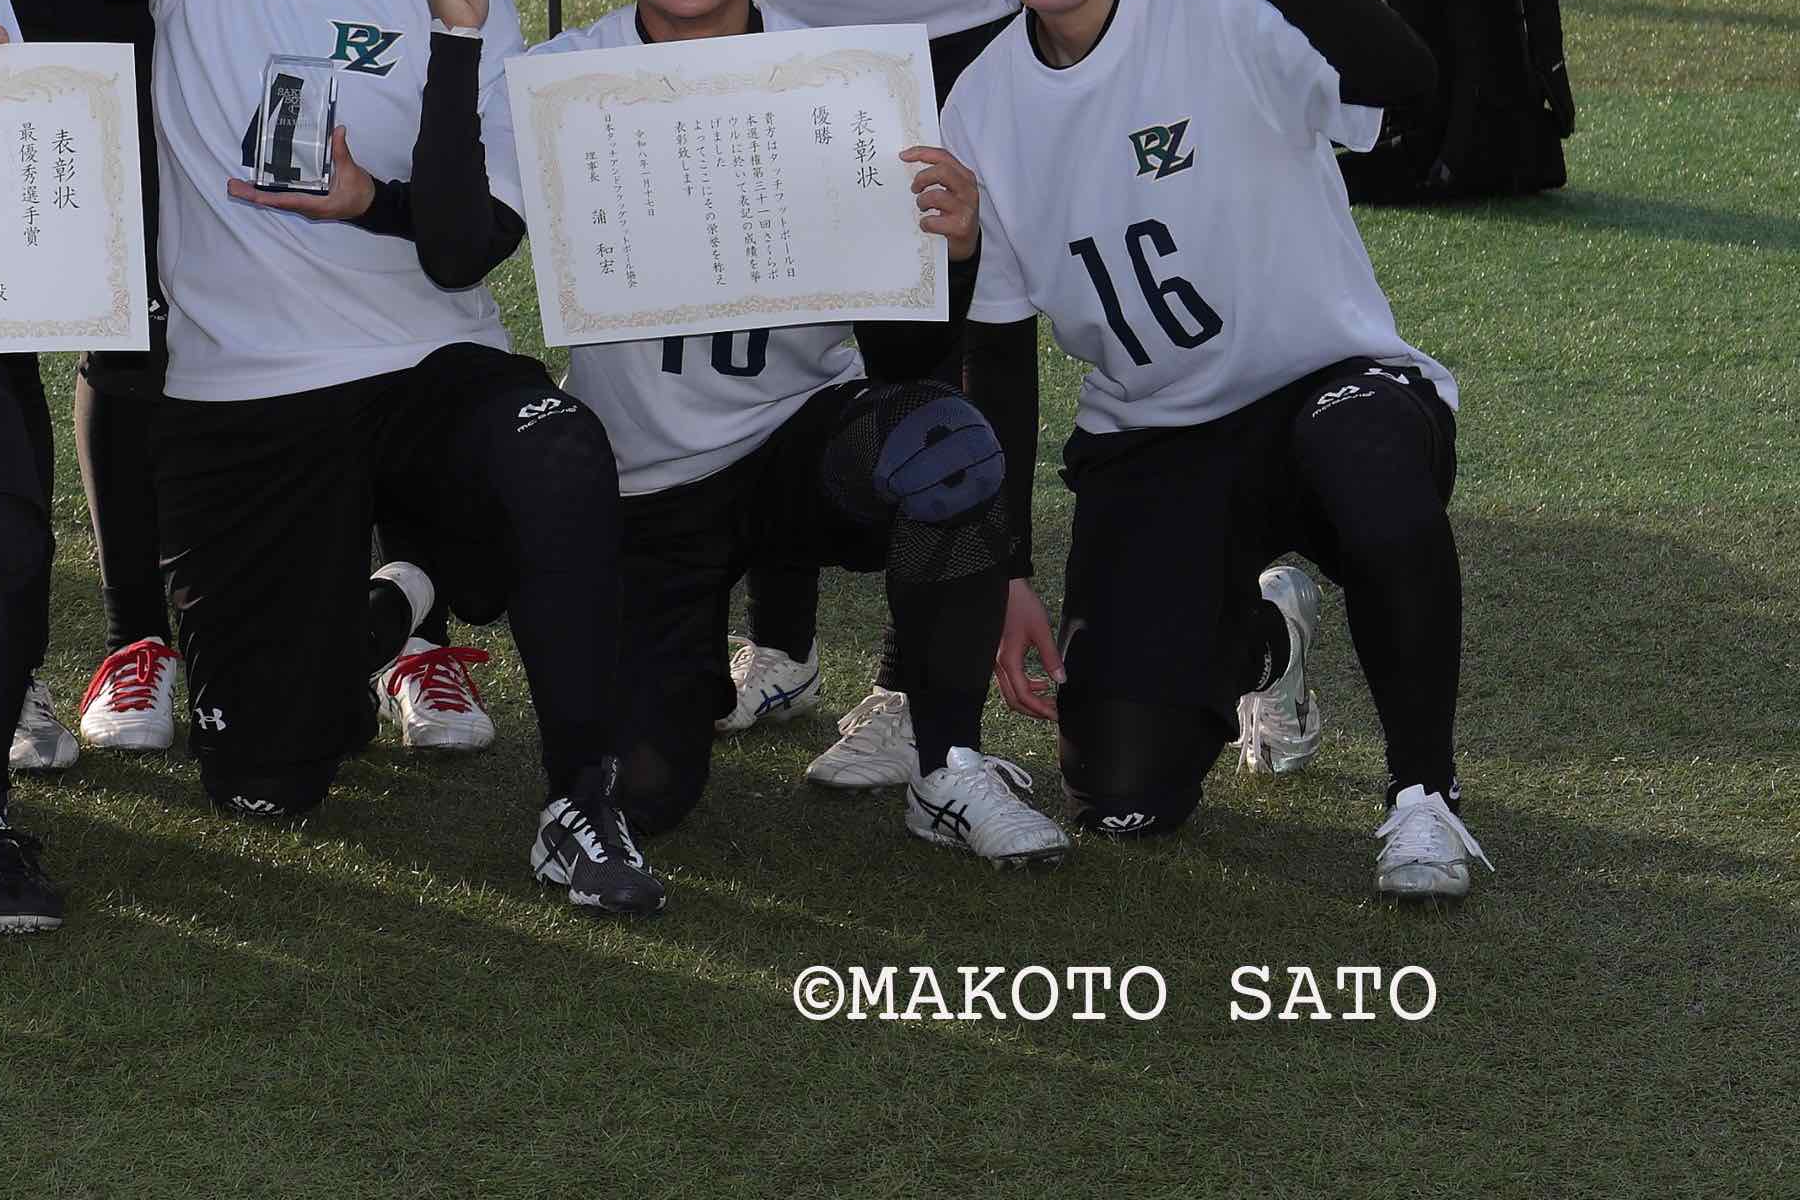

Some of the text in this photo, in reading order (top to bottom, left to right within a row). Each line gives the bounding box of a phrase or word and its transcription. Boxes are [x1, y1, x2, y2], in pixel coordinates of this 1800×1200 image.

[810, 104, 833, 146] 優勝
[849, 109, 885, 189] 表彰状
[18, 121, 41, 248] 最優秀選手賞
[51, 128, 81, 210] 表彰状
[1068, 218, 1224, 367] 16
